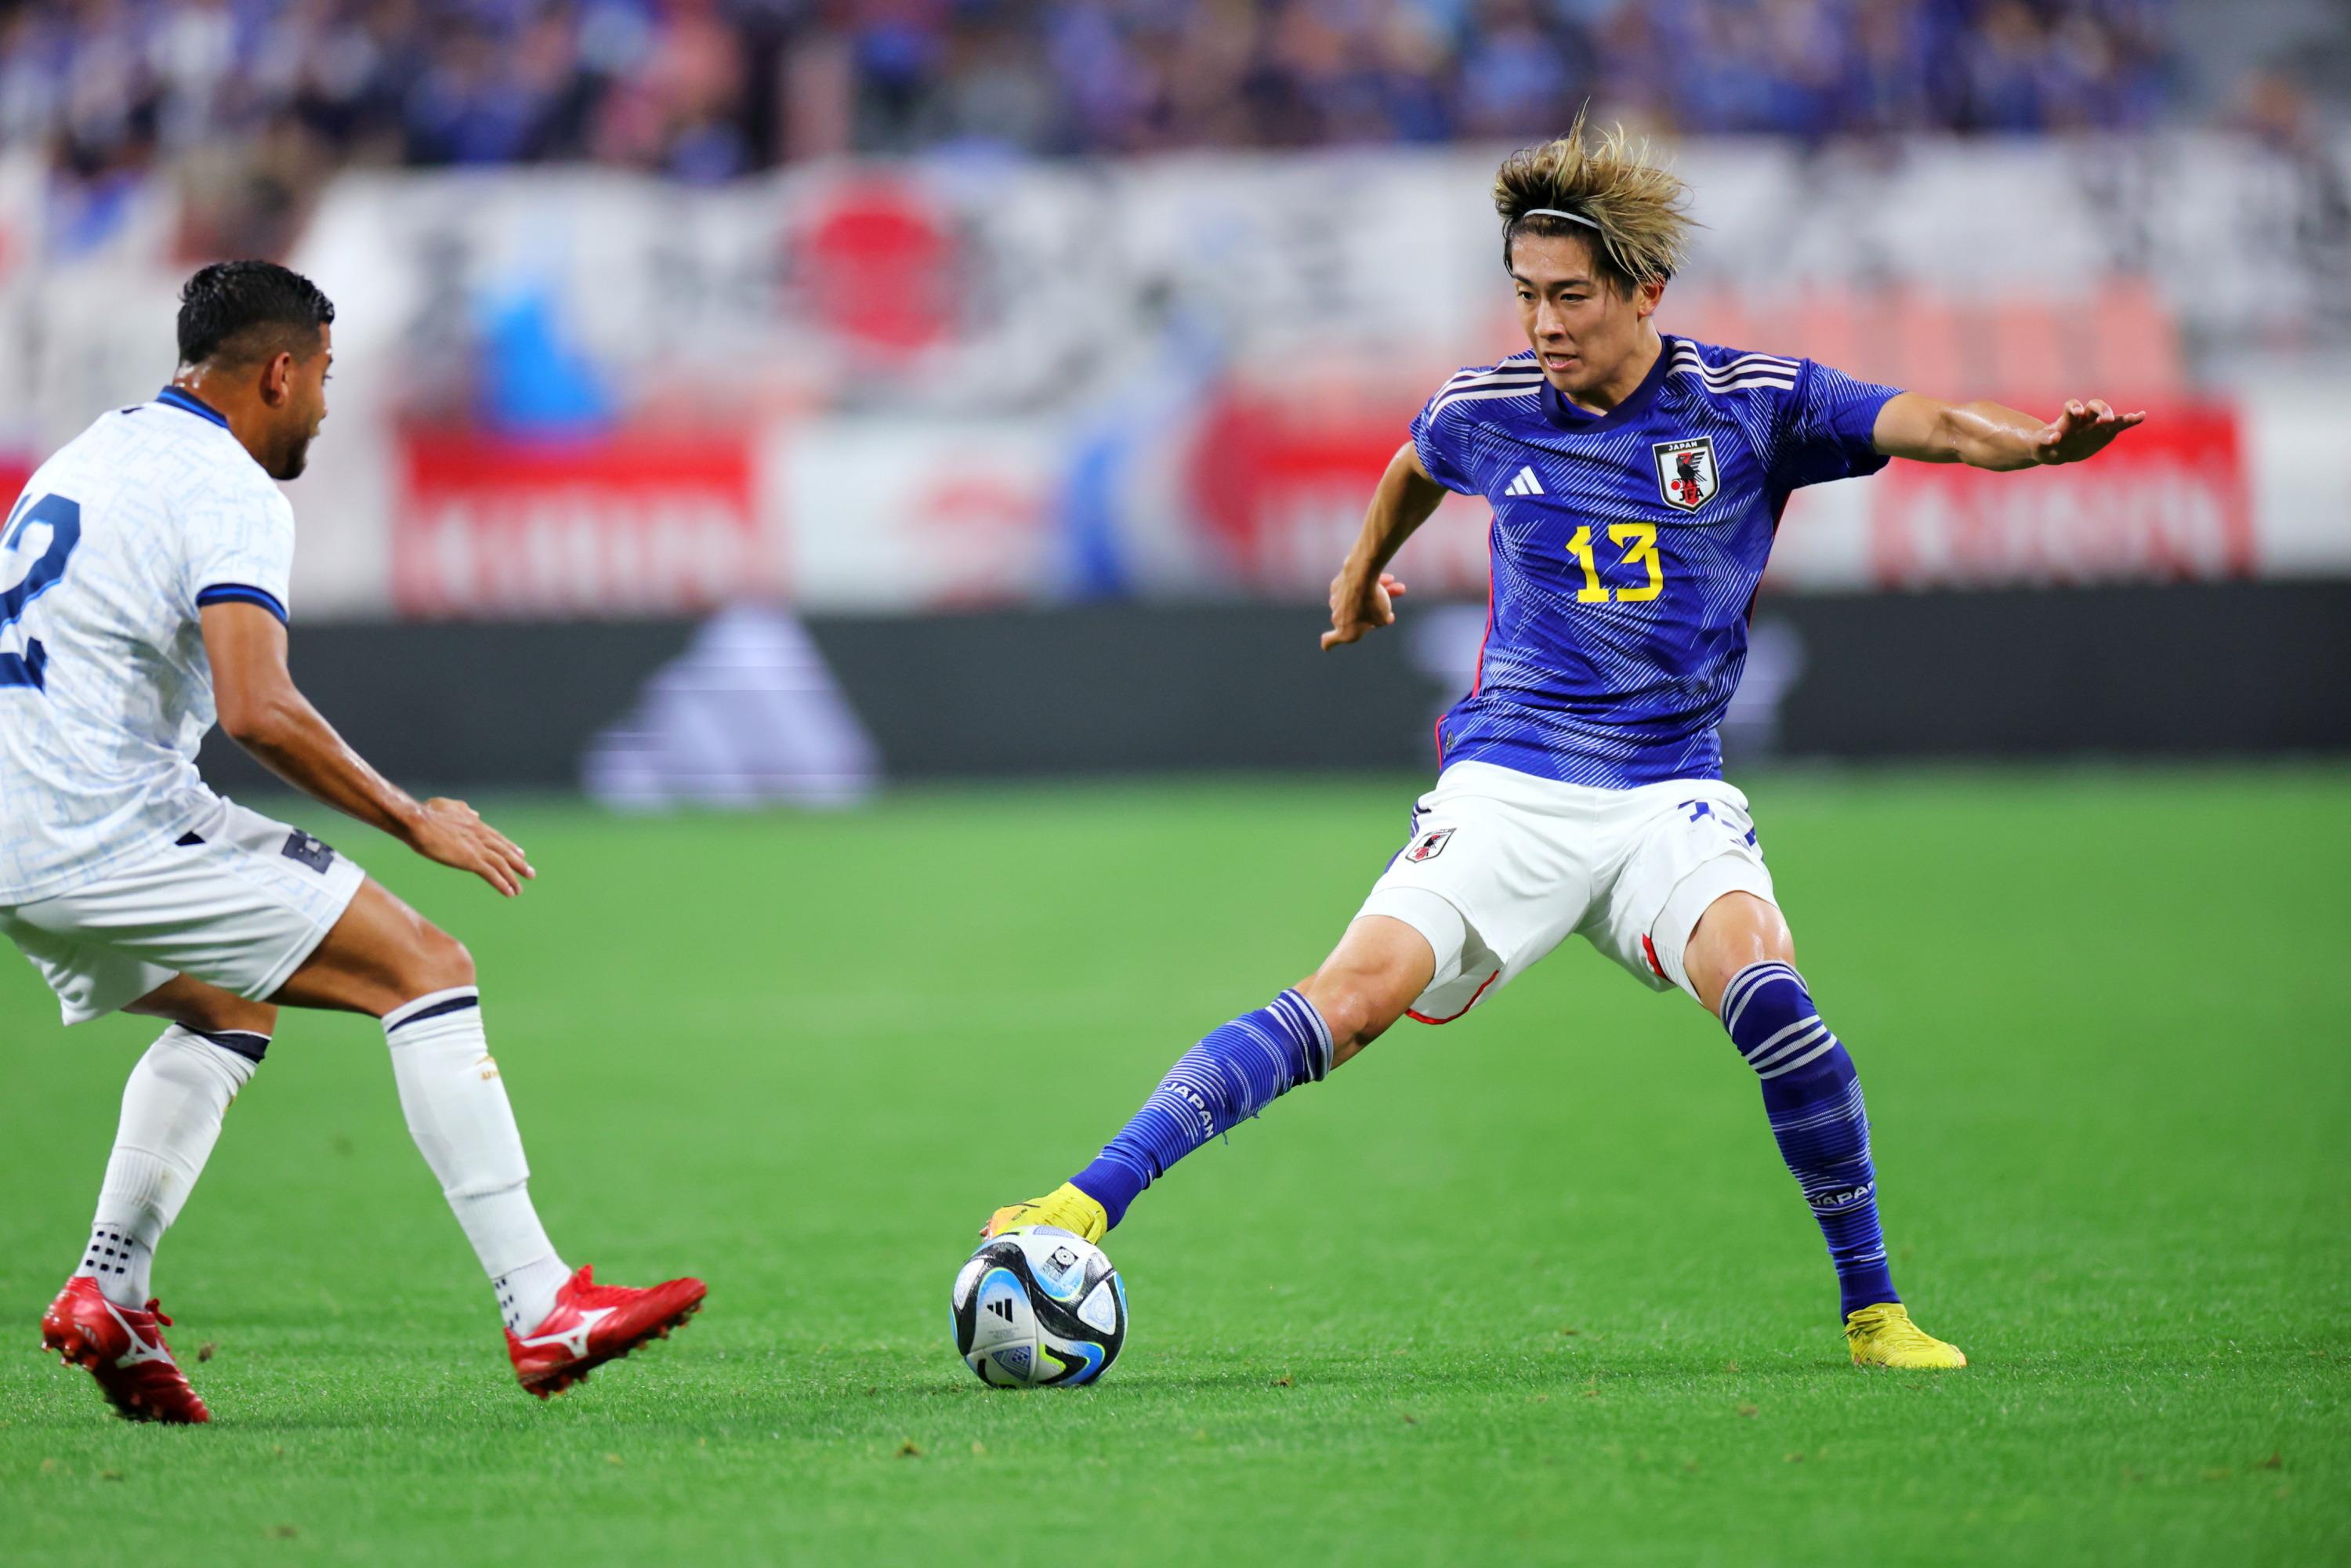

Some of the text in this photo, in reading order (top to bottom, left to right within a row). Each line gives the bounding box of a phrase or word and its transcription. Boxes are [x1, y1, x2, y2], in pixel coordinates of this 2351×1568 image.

[1668, 441, 1697, 451] JAPAN
[1679, 487, 1704, 502] JFA
[1565, 522, 1663, 603] 13
[1164, 1082, 1214, 1138] JAPAN
